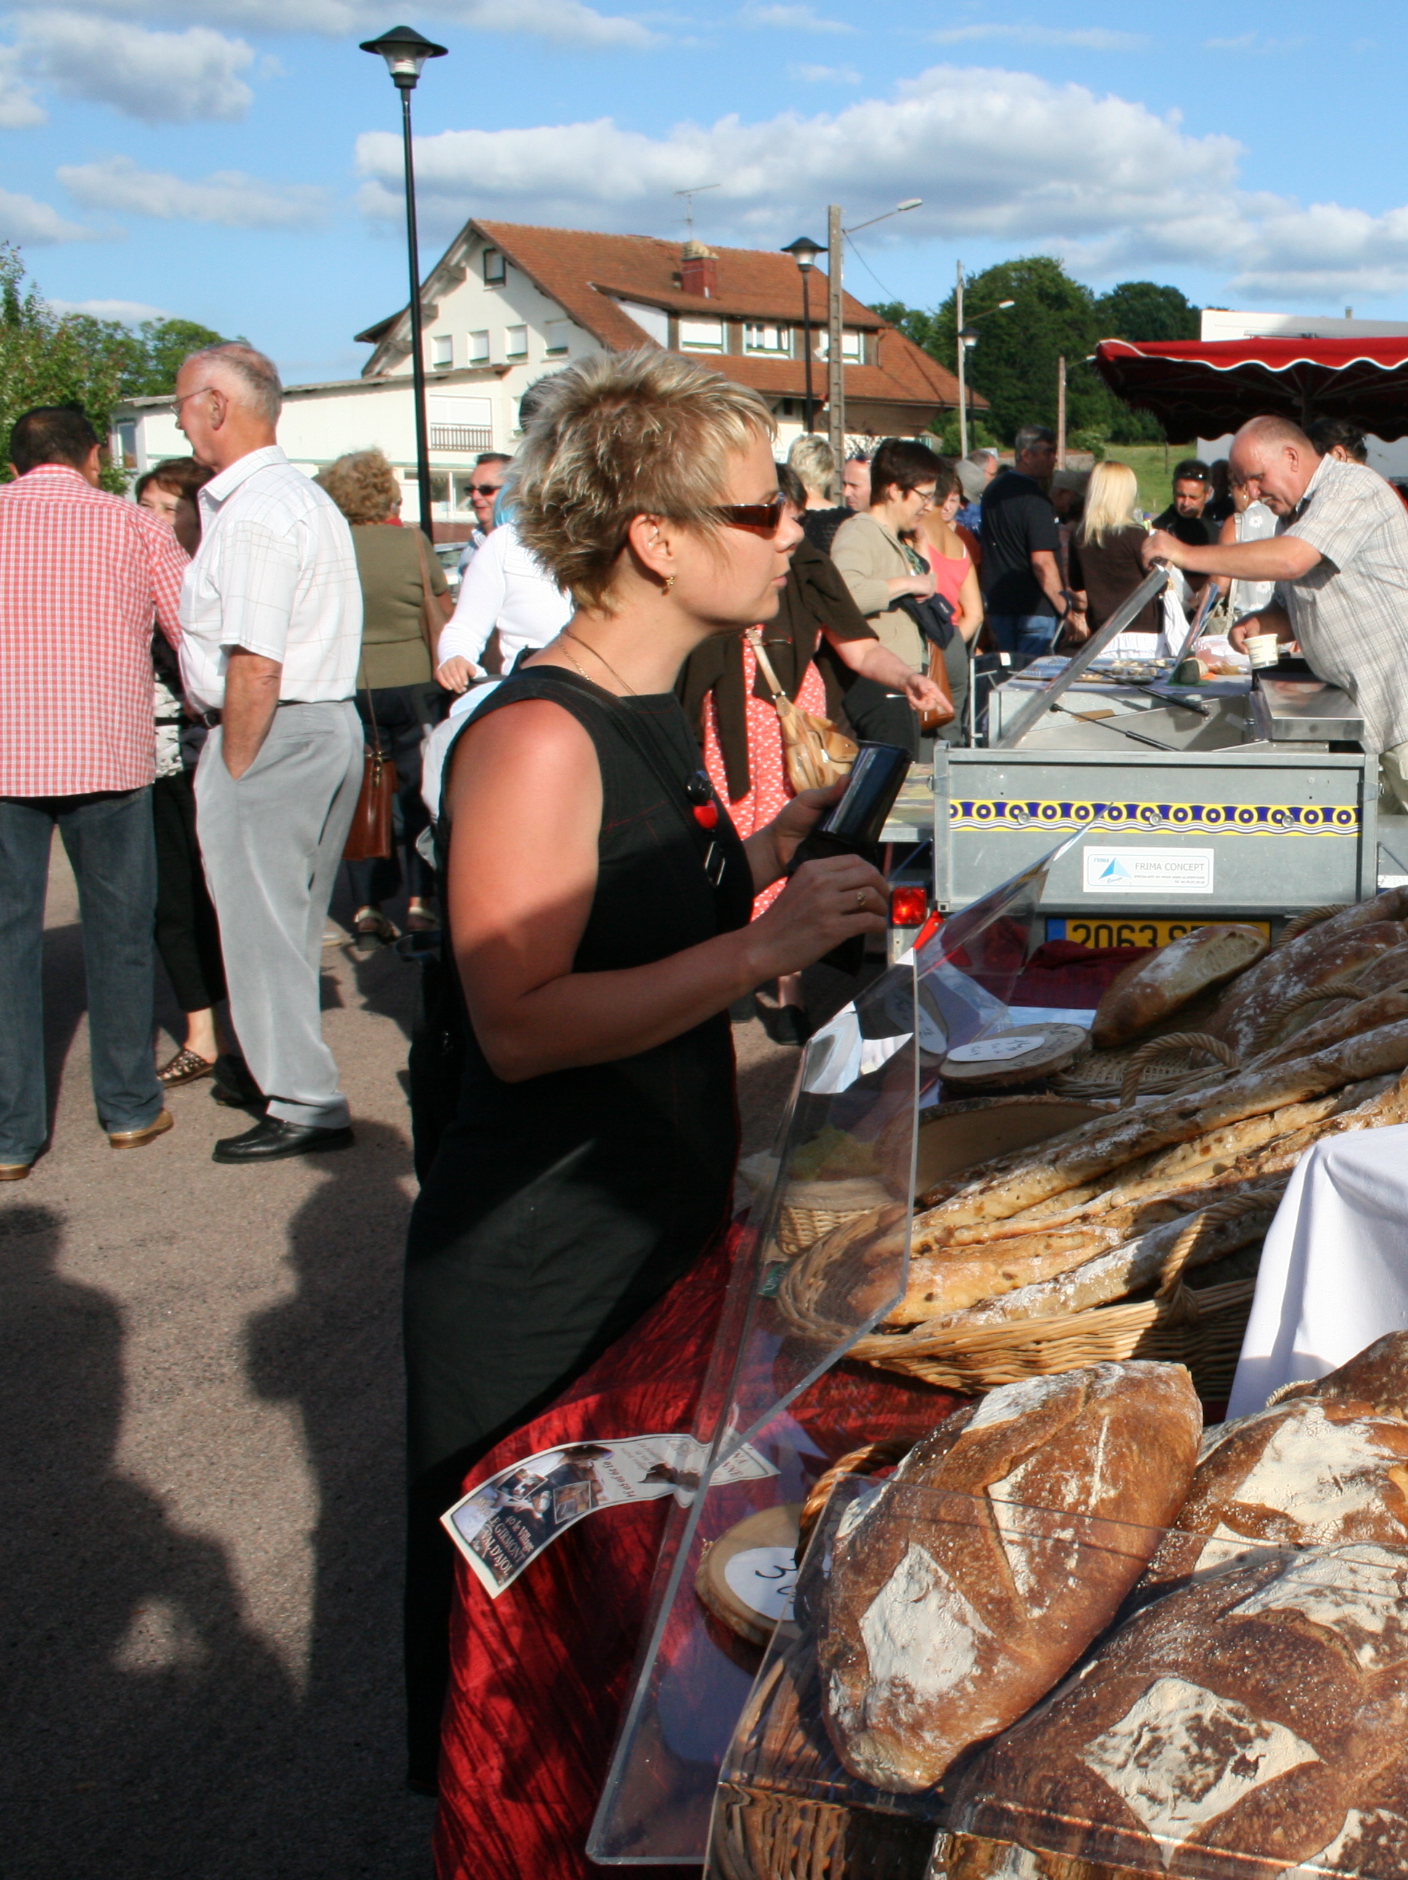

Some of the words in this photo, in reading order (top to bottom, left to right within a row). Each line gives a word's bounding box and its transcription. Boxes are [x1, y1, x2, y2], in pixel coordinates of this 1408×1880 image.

[1135, 862, 1162, 871] FRIMA
[1164, 862, 1205, 872] CONCEPT
[1072, 923, 1158, 948] 2063
[481, 1529, 496, 1552] VAL
[489, 1544, 513, 1576] D'AJOL
[494, 1522, 527, 1563] GIRMONT
[512, 1520, 522, 1532] le
[518, 1526, 535, 1553] Village
